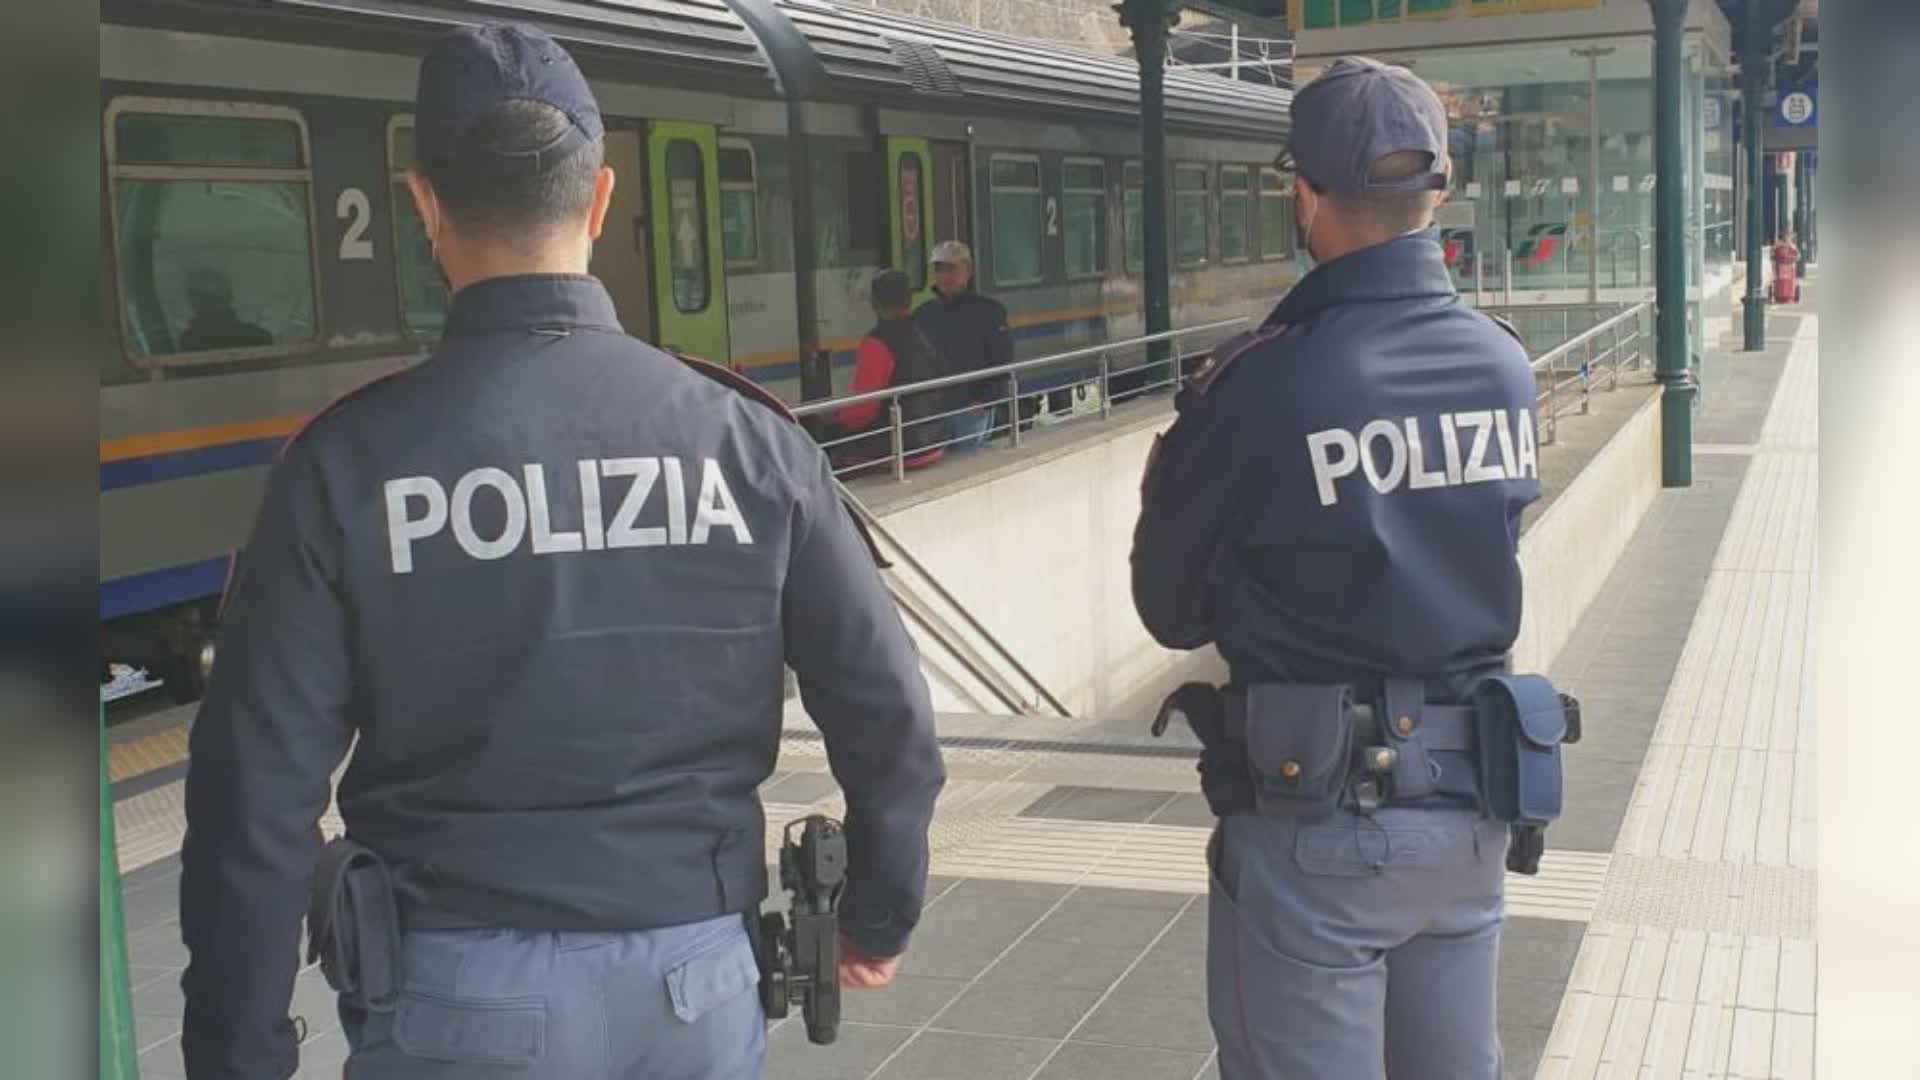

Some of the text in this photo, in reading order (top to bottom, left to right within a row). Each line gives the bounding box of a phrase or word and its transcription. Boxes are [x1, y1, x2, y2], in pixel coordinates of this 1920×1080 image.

[336, 187, 374, 259] 2
[1046, 196, 1057, 236] 2
[1306, 408, 1538, 507] POLIZIA
[384, 456, 754, 574] POLIZIA
